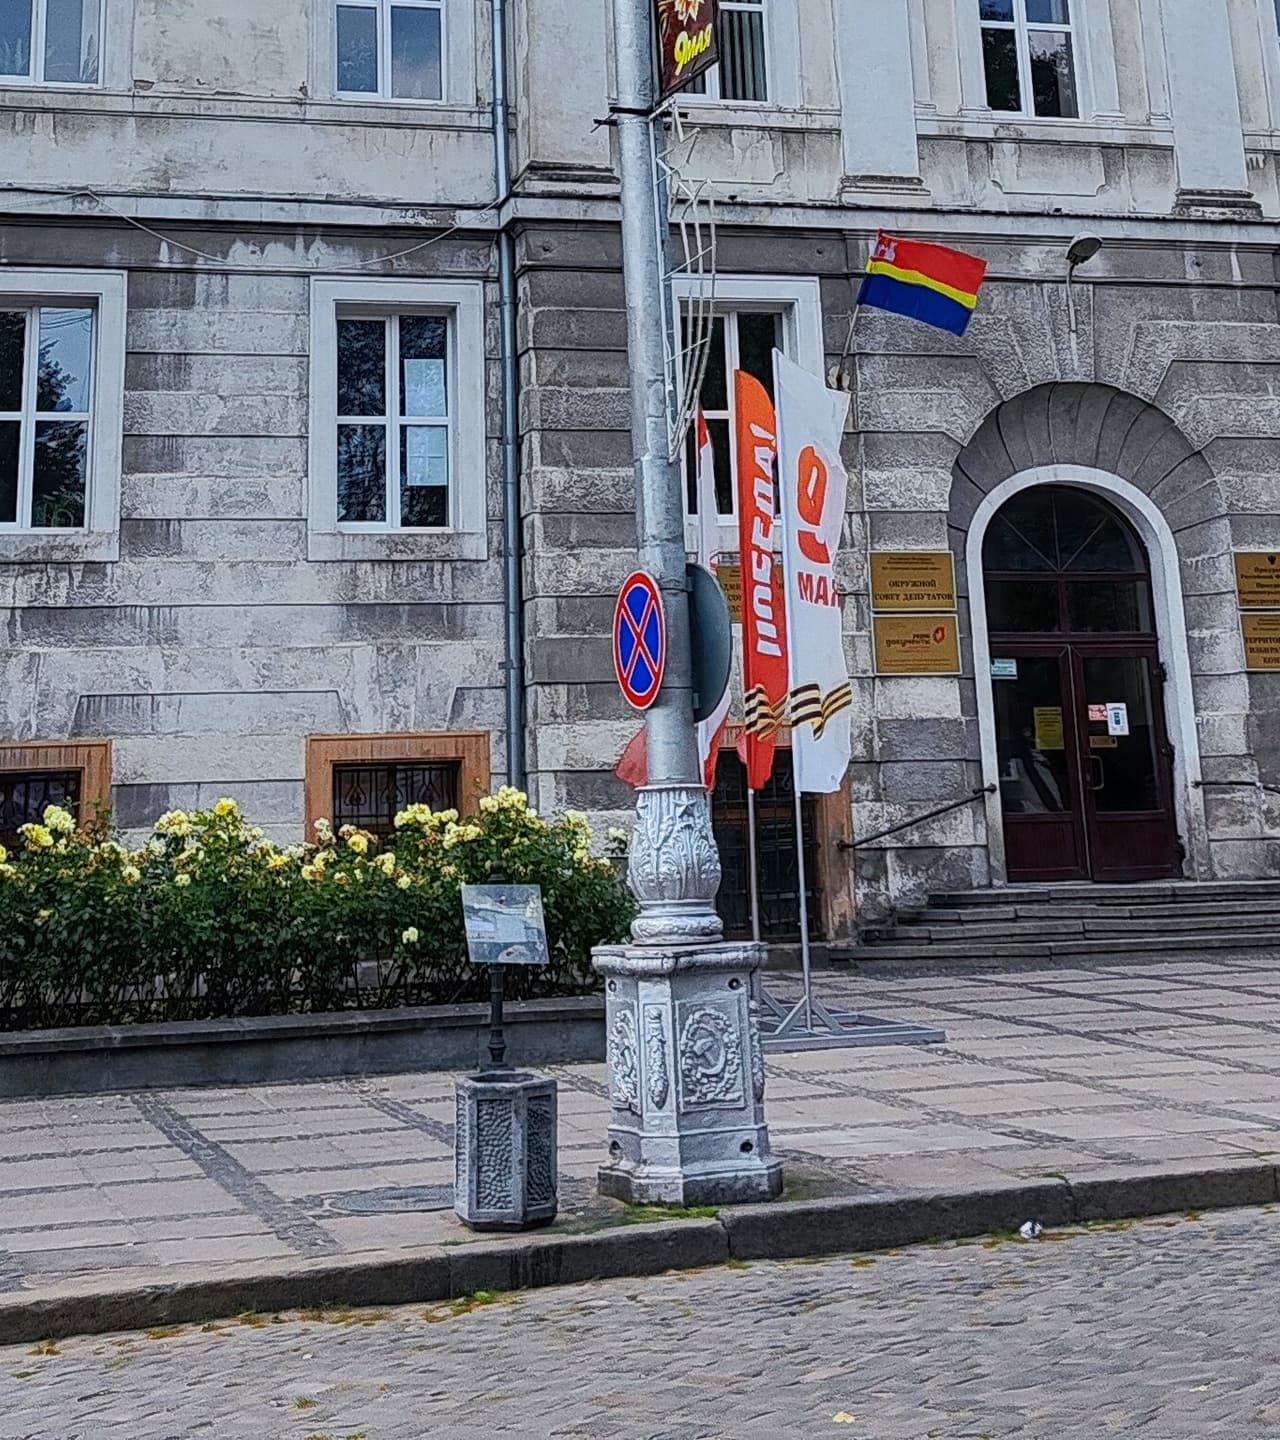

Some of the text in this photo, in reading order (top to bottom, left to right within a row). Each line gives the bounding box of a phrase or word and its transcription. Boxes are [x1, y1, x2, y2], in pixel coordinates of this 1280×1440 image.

[797, 444, 831, 564] 9
[888, 579, 937, 588] ОКРУЖНОЙ
[874, 593, 953, 602] СОВЕТ ДЕПУТАТОВ
